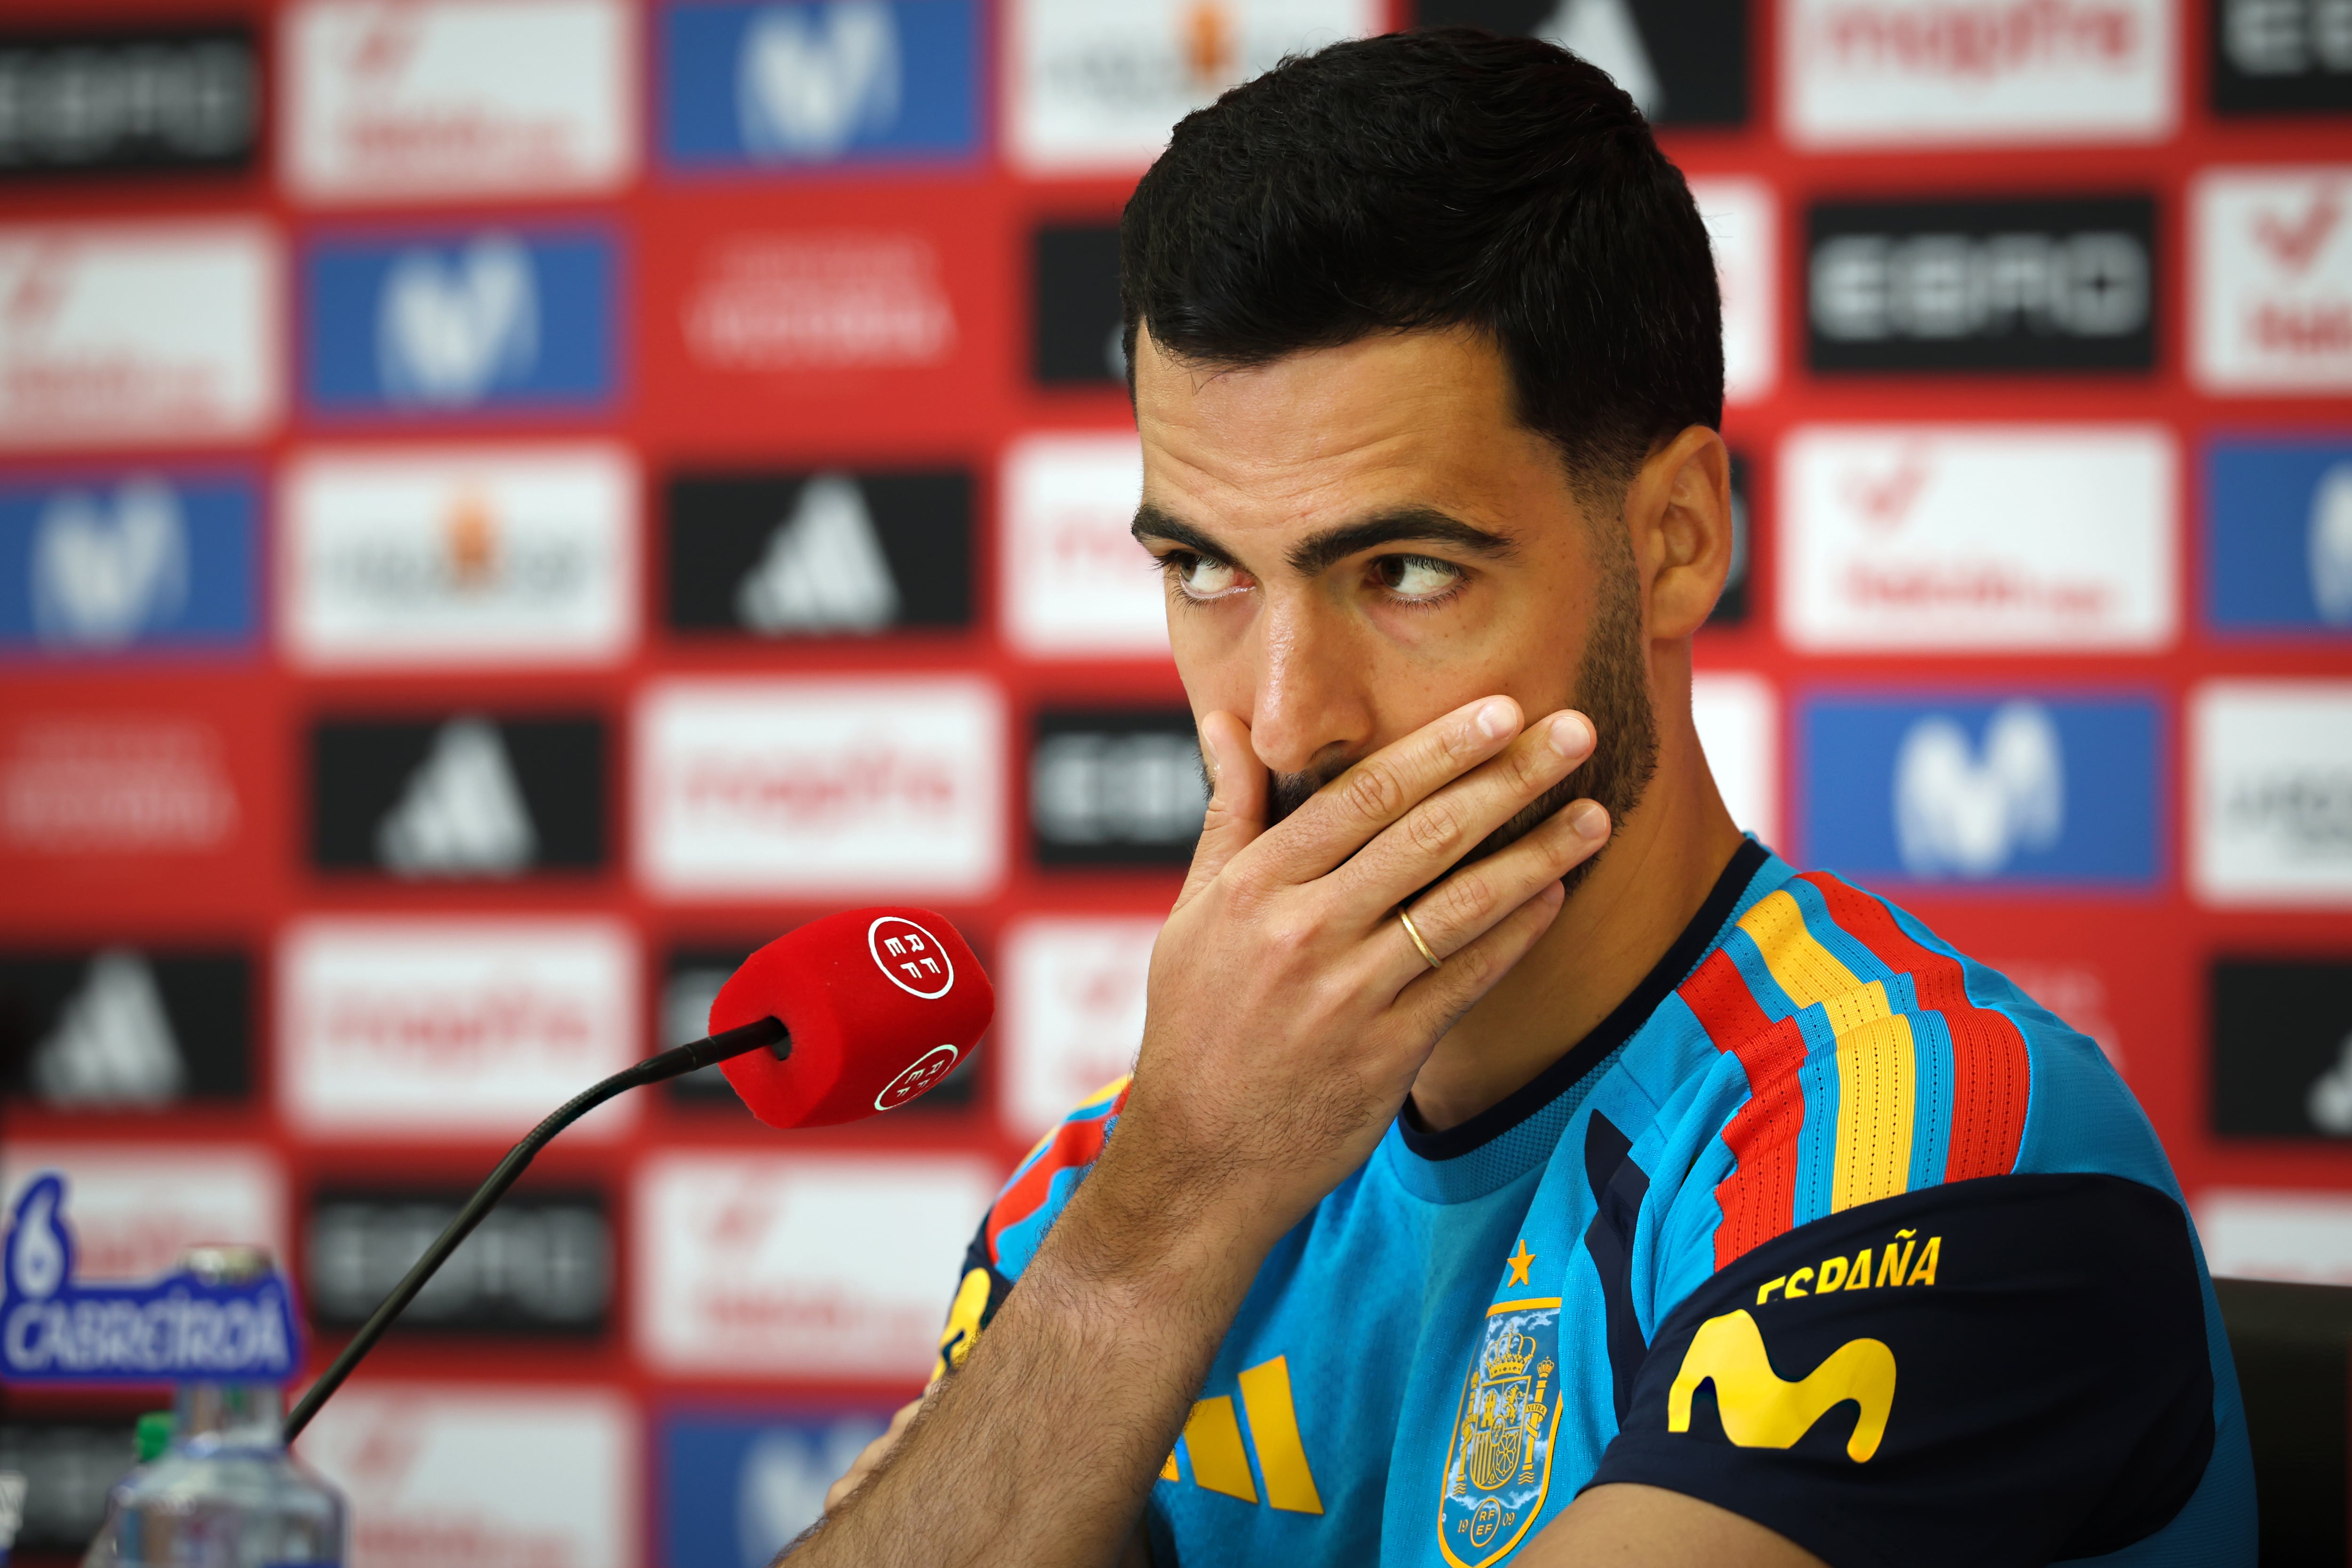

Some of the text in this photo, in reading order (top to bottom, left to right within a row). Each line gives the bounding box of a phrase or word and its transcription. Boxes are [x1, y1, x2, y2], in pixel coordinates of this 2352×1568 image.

[1809, 233, 2151, 340] EBRO
[1457, 1519, 1469, 1533] 19
[1502, 1512, 1516, 1526] 09
